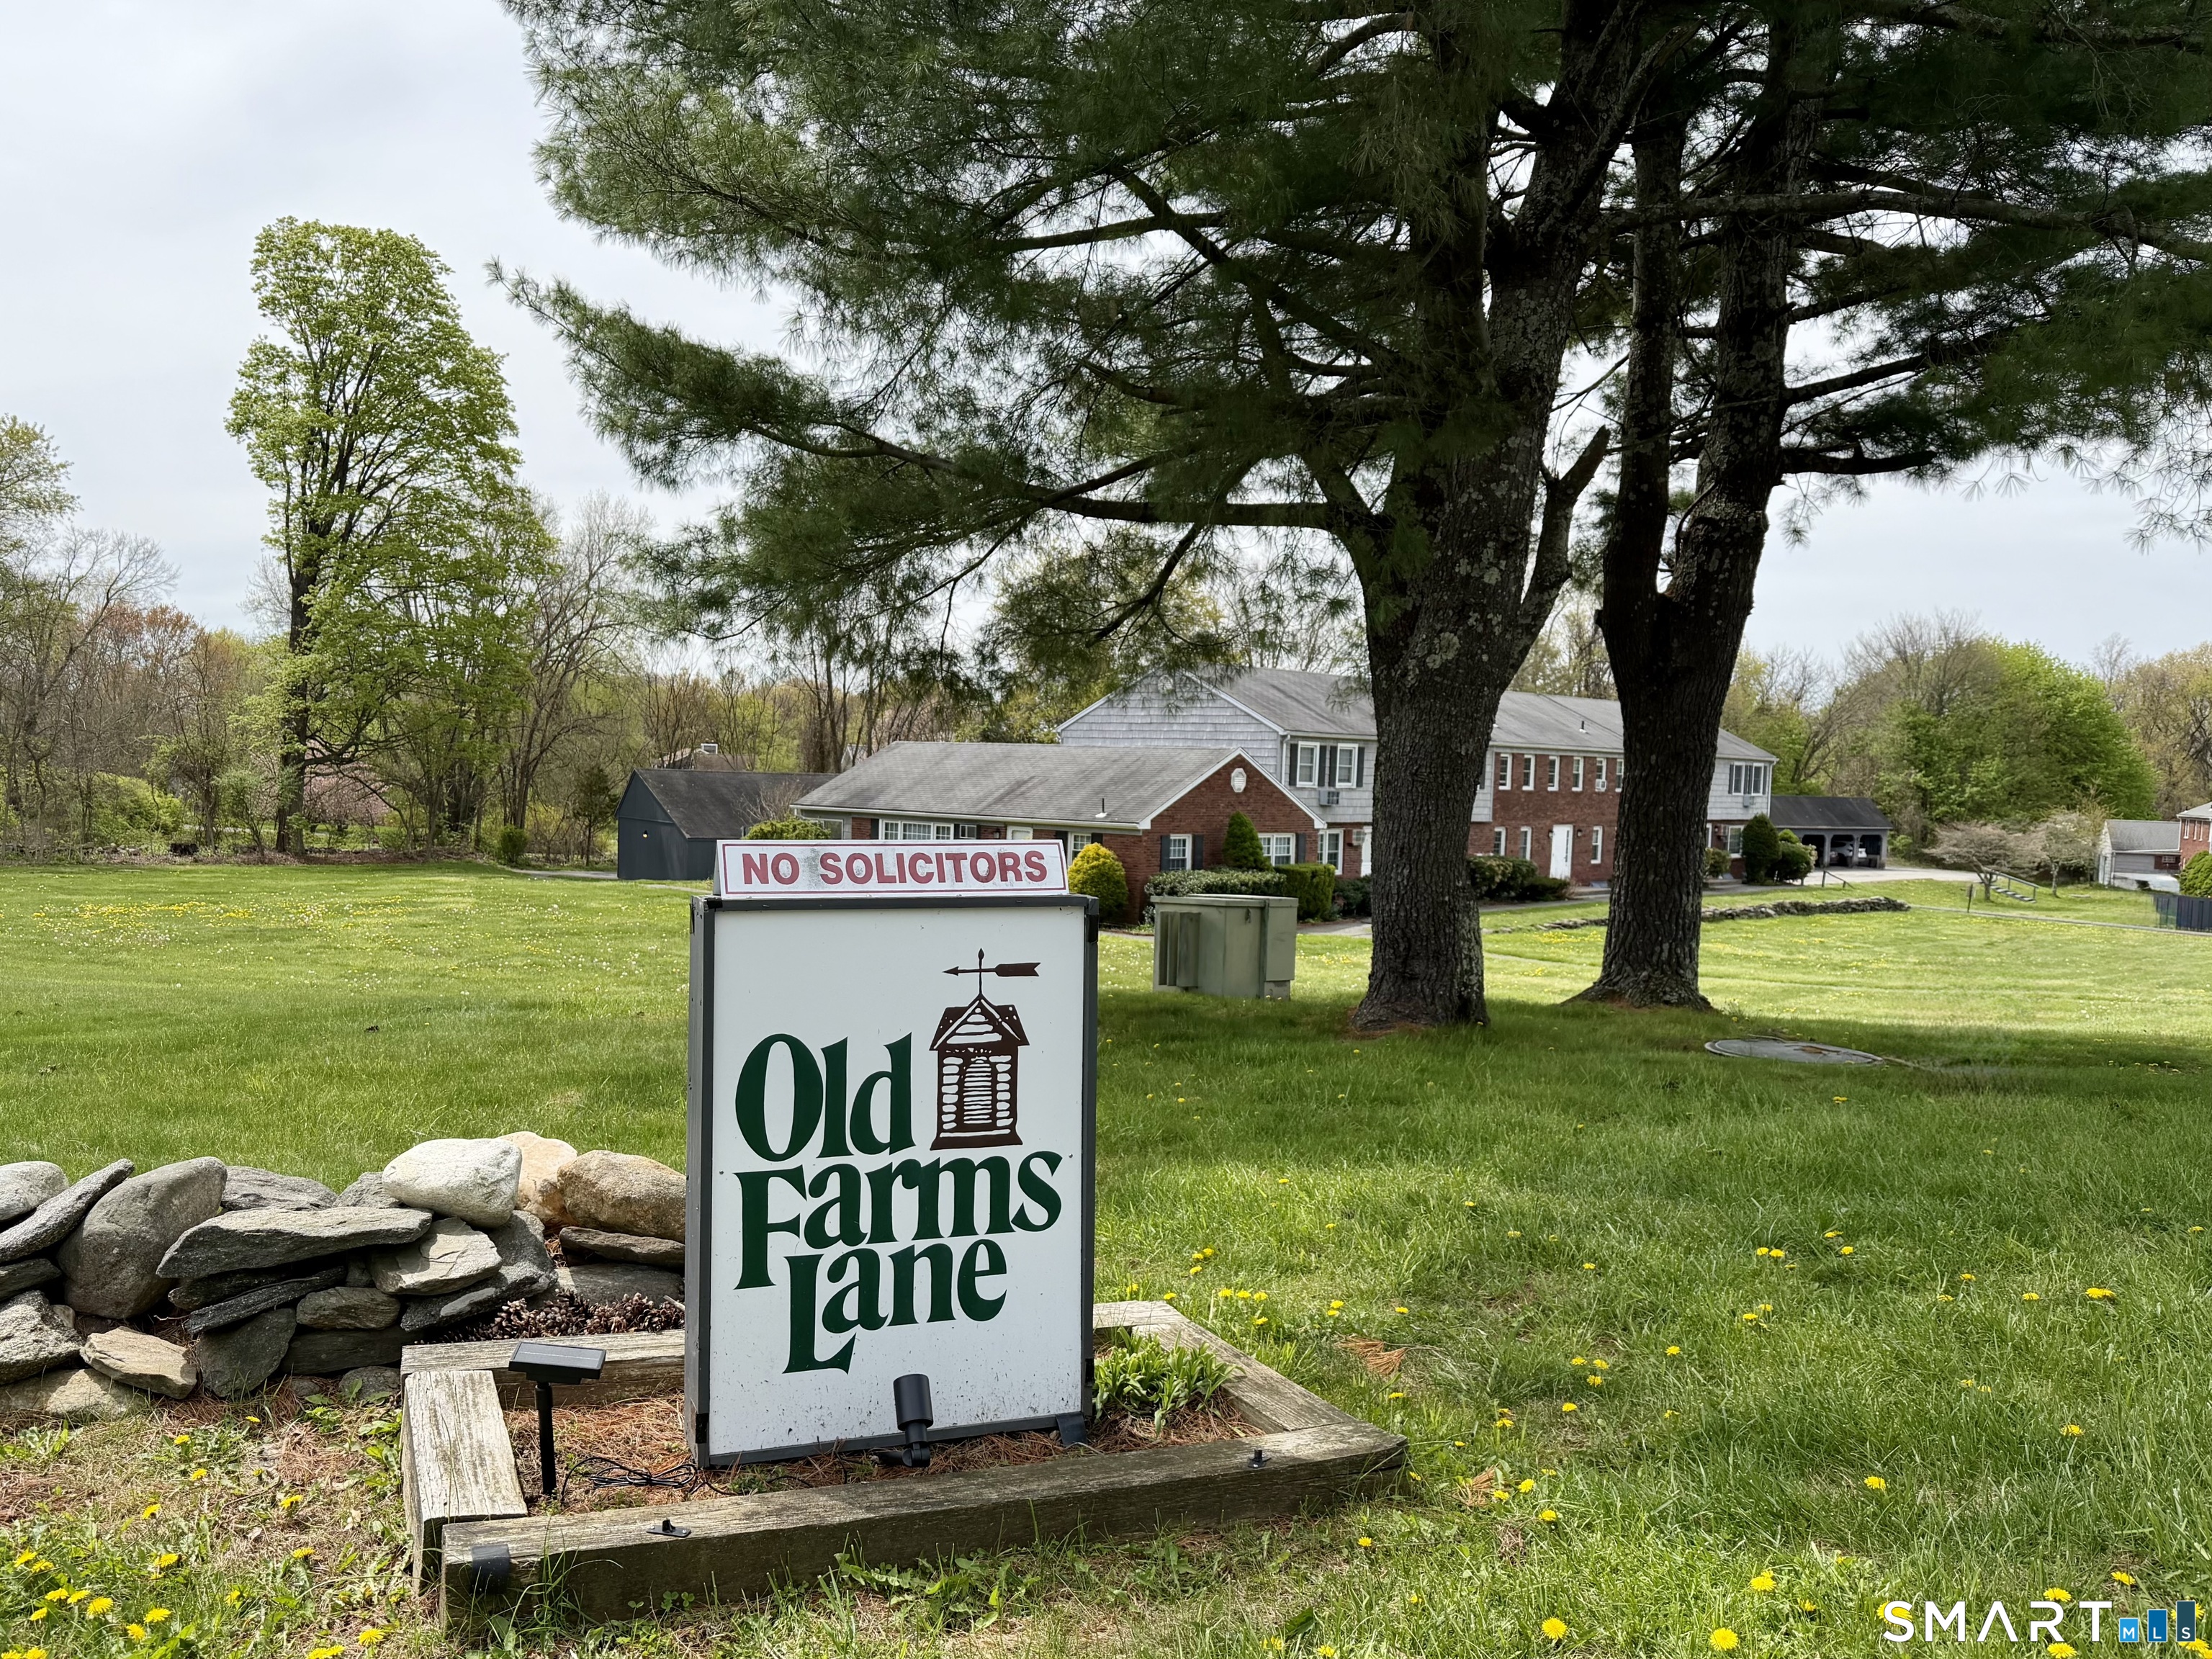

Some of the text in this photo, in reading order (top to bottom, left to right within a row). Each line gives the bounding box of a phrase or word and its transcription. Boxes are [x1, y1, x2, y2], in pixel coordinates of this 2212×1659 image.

[742, 850, 1048, 885] NO SOLICITORS
[734, 1032, 917, 1162] Old
[732, 1150, 1064, 1290] Farms
[781, 1238, 1007, 1375] Lane
